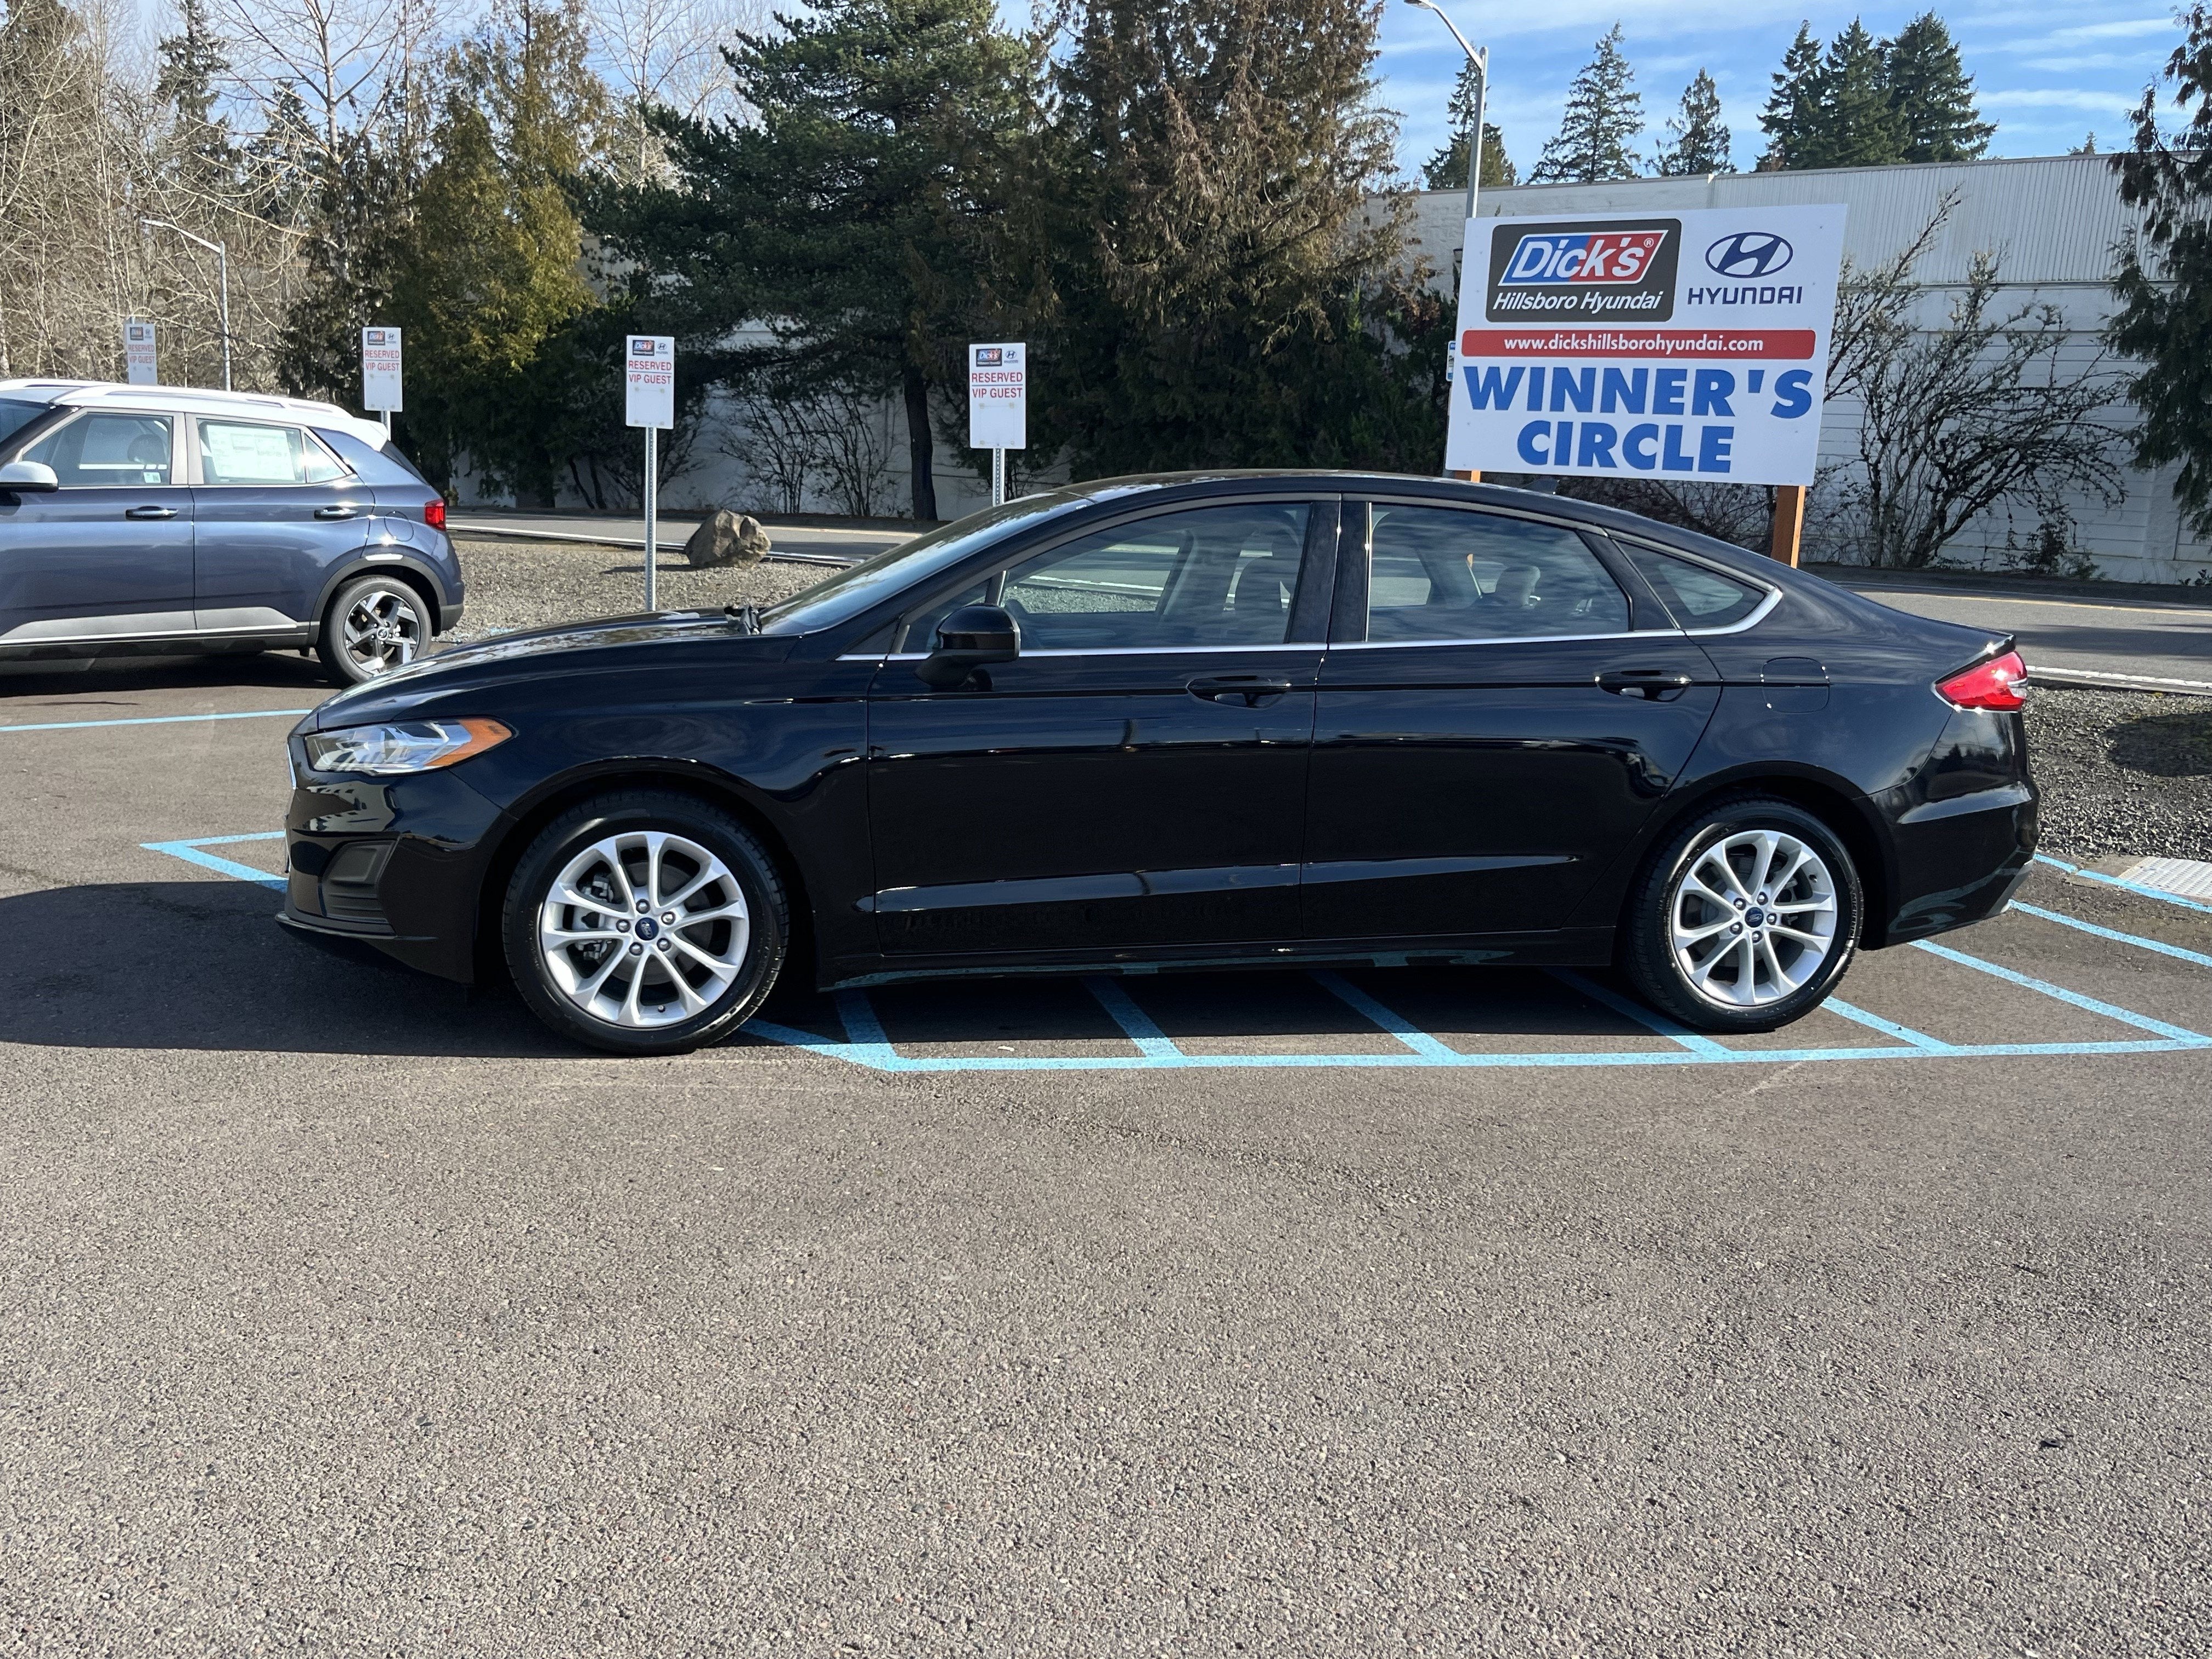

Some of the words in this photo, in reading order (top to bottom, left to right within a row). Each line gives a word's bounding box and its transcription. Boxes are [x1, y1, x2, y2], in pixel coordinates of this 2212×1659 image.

[1688, 286, 1802, 305] HYUNDAI
[1492, 292, 1577, 310] Hillsboro
[1580, 291, 1664, 314] Hyundai
[1504, 334, 1764, 355] www.dickshillsborohyundai.com
[365, 350, 399, 359] RESERVED
[365, 363, 376, 371] VIP
[377, 363, 399, 371] GUEST
[628, 360, 672, 371] RESERVED
[629, 374, 641, 383] VIP
[644, 374, 672, 384] GUEST
[972, 372, 1023, 383] RESERVED
[973, 388, 987, 398] VIP
[990, 388, 1023, 398] GUEST
[1463, 366, 1814, 419] WINNER'S
[1517, 420, 1735, 474] CIRCLE
